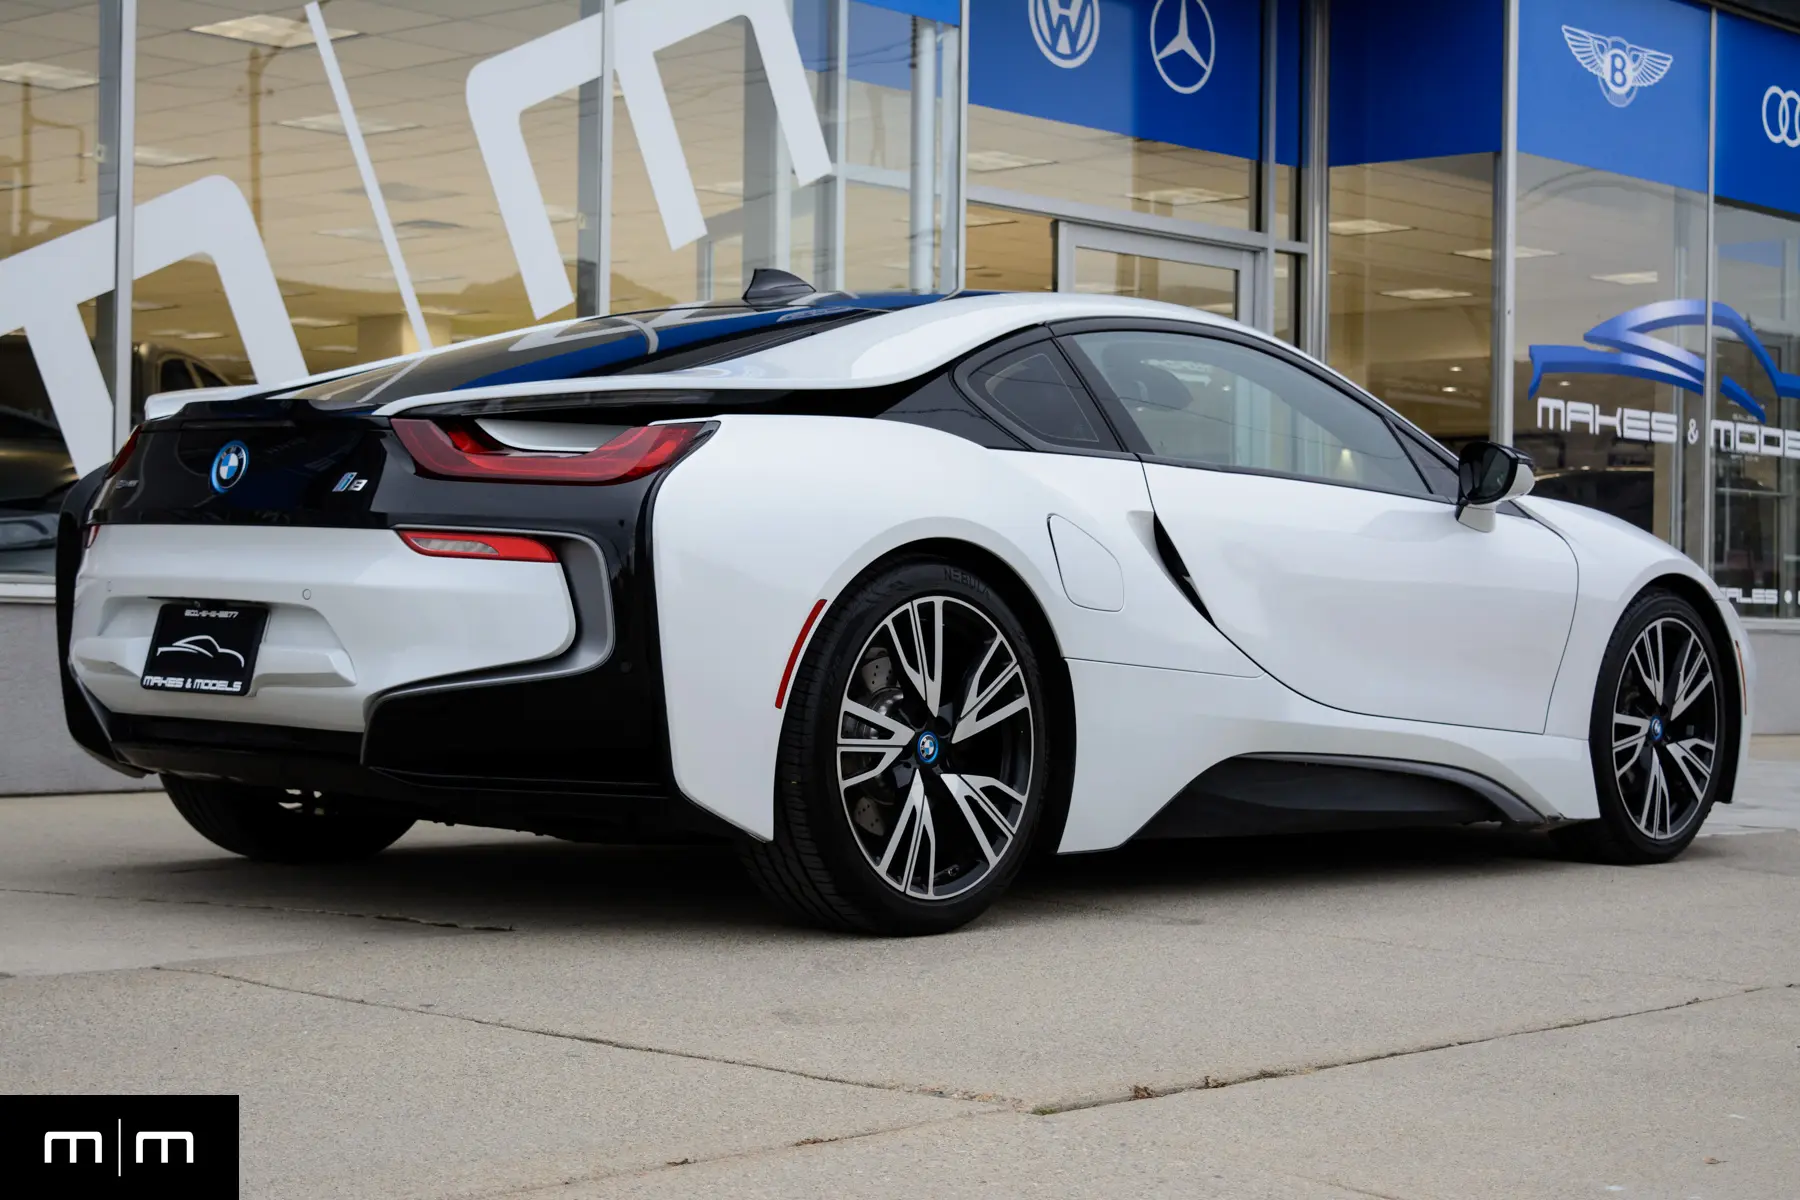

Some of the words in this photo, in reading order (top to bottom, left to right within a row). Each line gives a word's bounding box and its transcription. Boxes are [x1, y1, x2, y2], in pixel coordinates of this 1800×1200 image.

[1537, 396, 1677, 443] MAKES
[1687, 418, 1699, 445] &
[332, 472, 368, 492] i8
[142, 675, 184, 688] MAKES
[185, 677, 193, 689] &
[193, 678, 243, 692] MODELS
